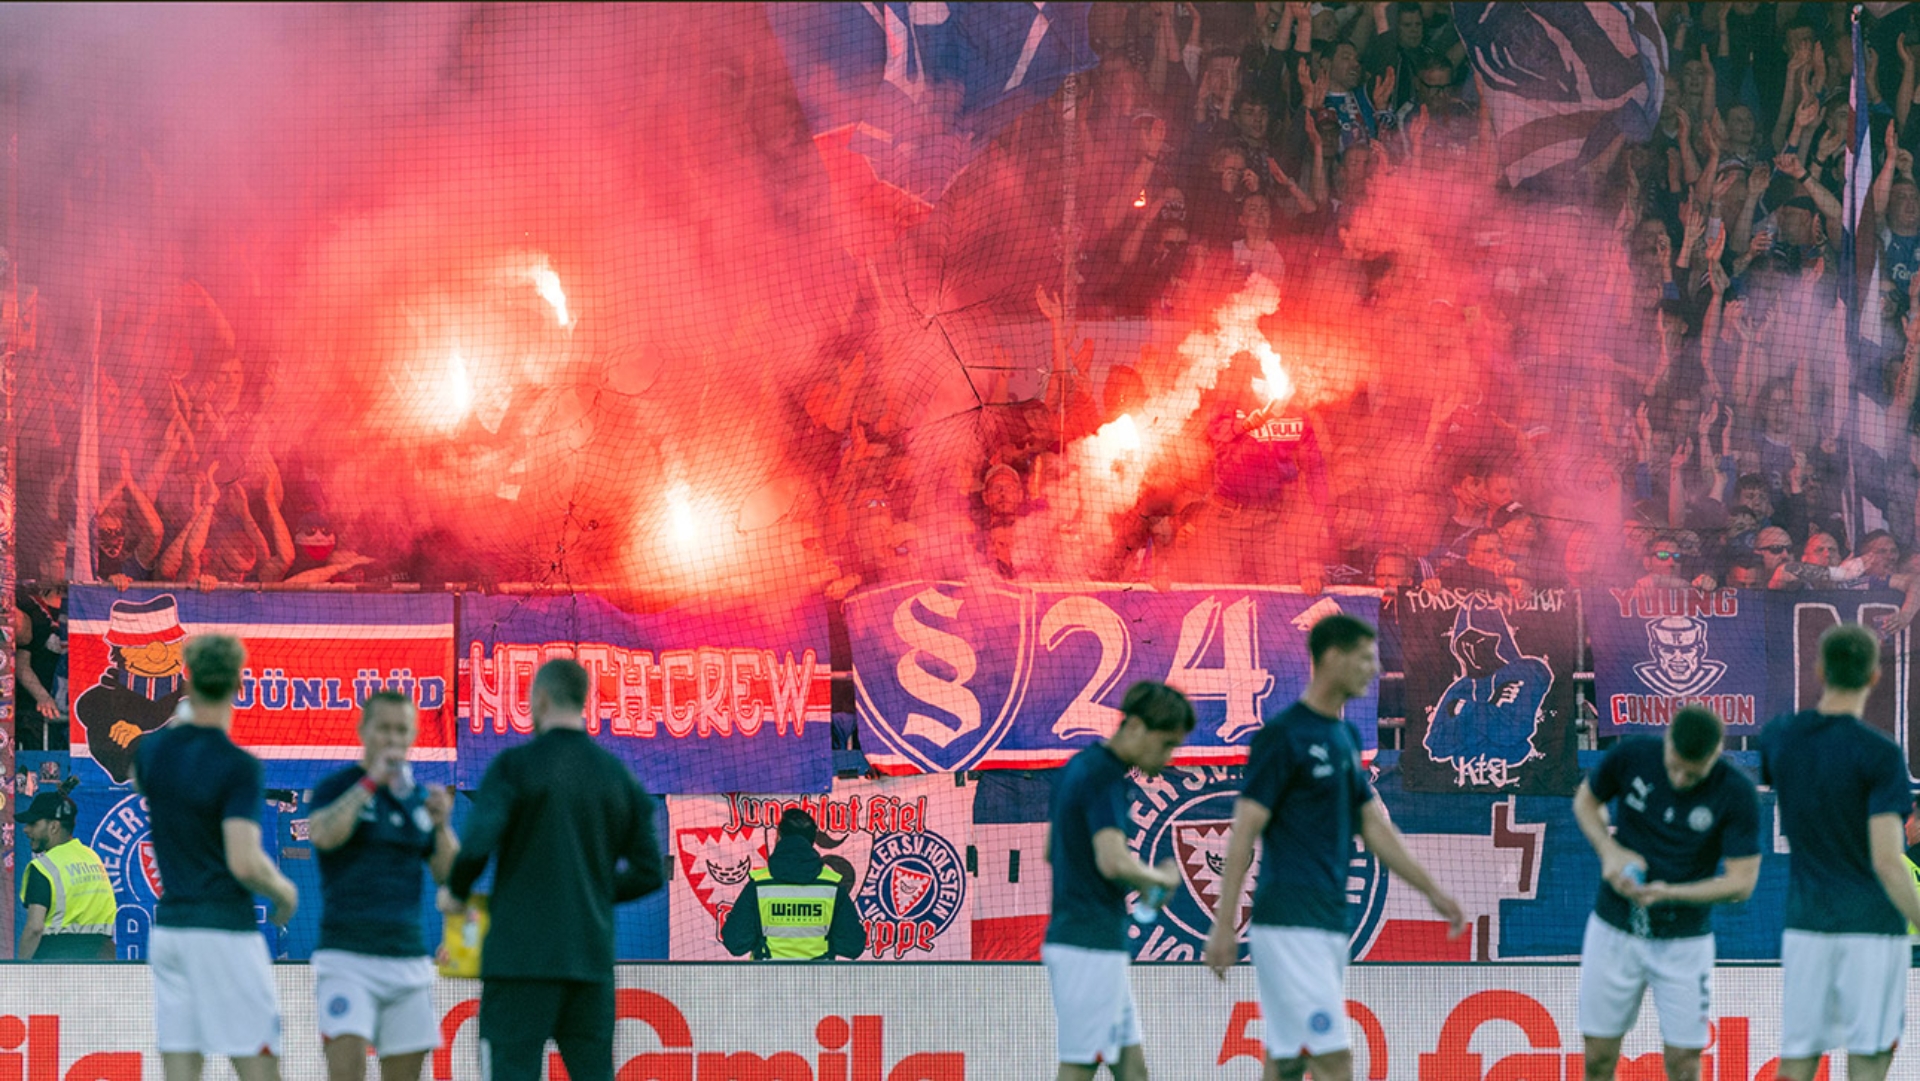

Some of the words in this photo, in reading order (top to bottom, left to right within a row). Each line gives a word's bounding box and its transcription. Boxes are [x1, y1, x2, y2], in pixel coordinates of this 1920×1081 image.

[1609, 587, 1738, 618] YOUNG
[229, 668, 446, 711] ÜÜNLÜÜD
[721, 792, 863, 833] Junblut
[865, 795, 928, 834] Kiel
[860, 839, 902, 897] KIELER
[922, 840, 959, 921] HOLSTEIN
